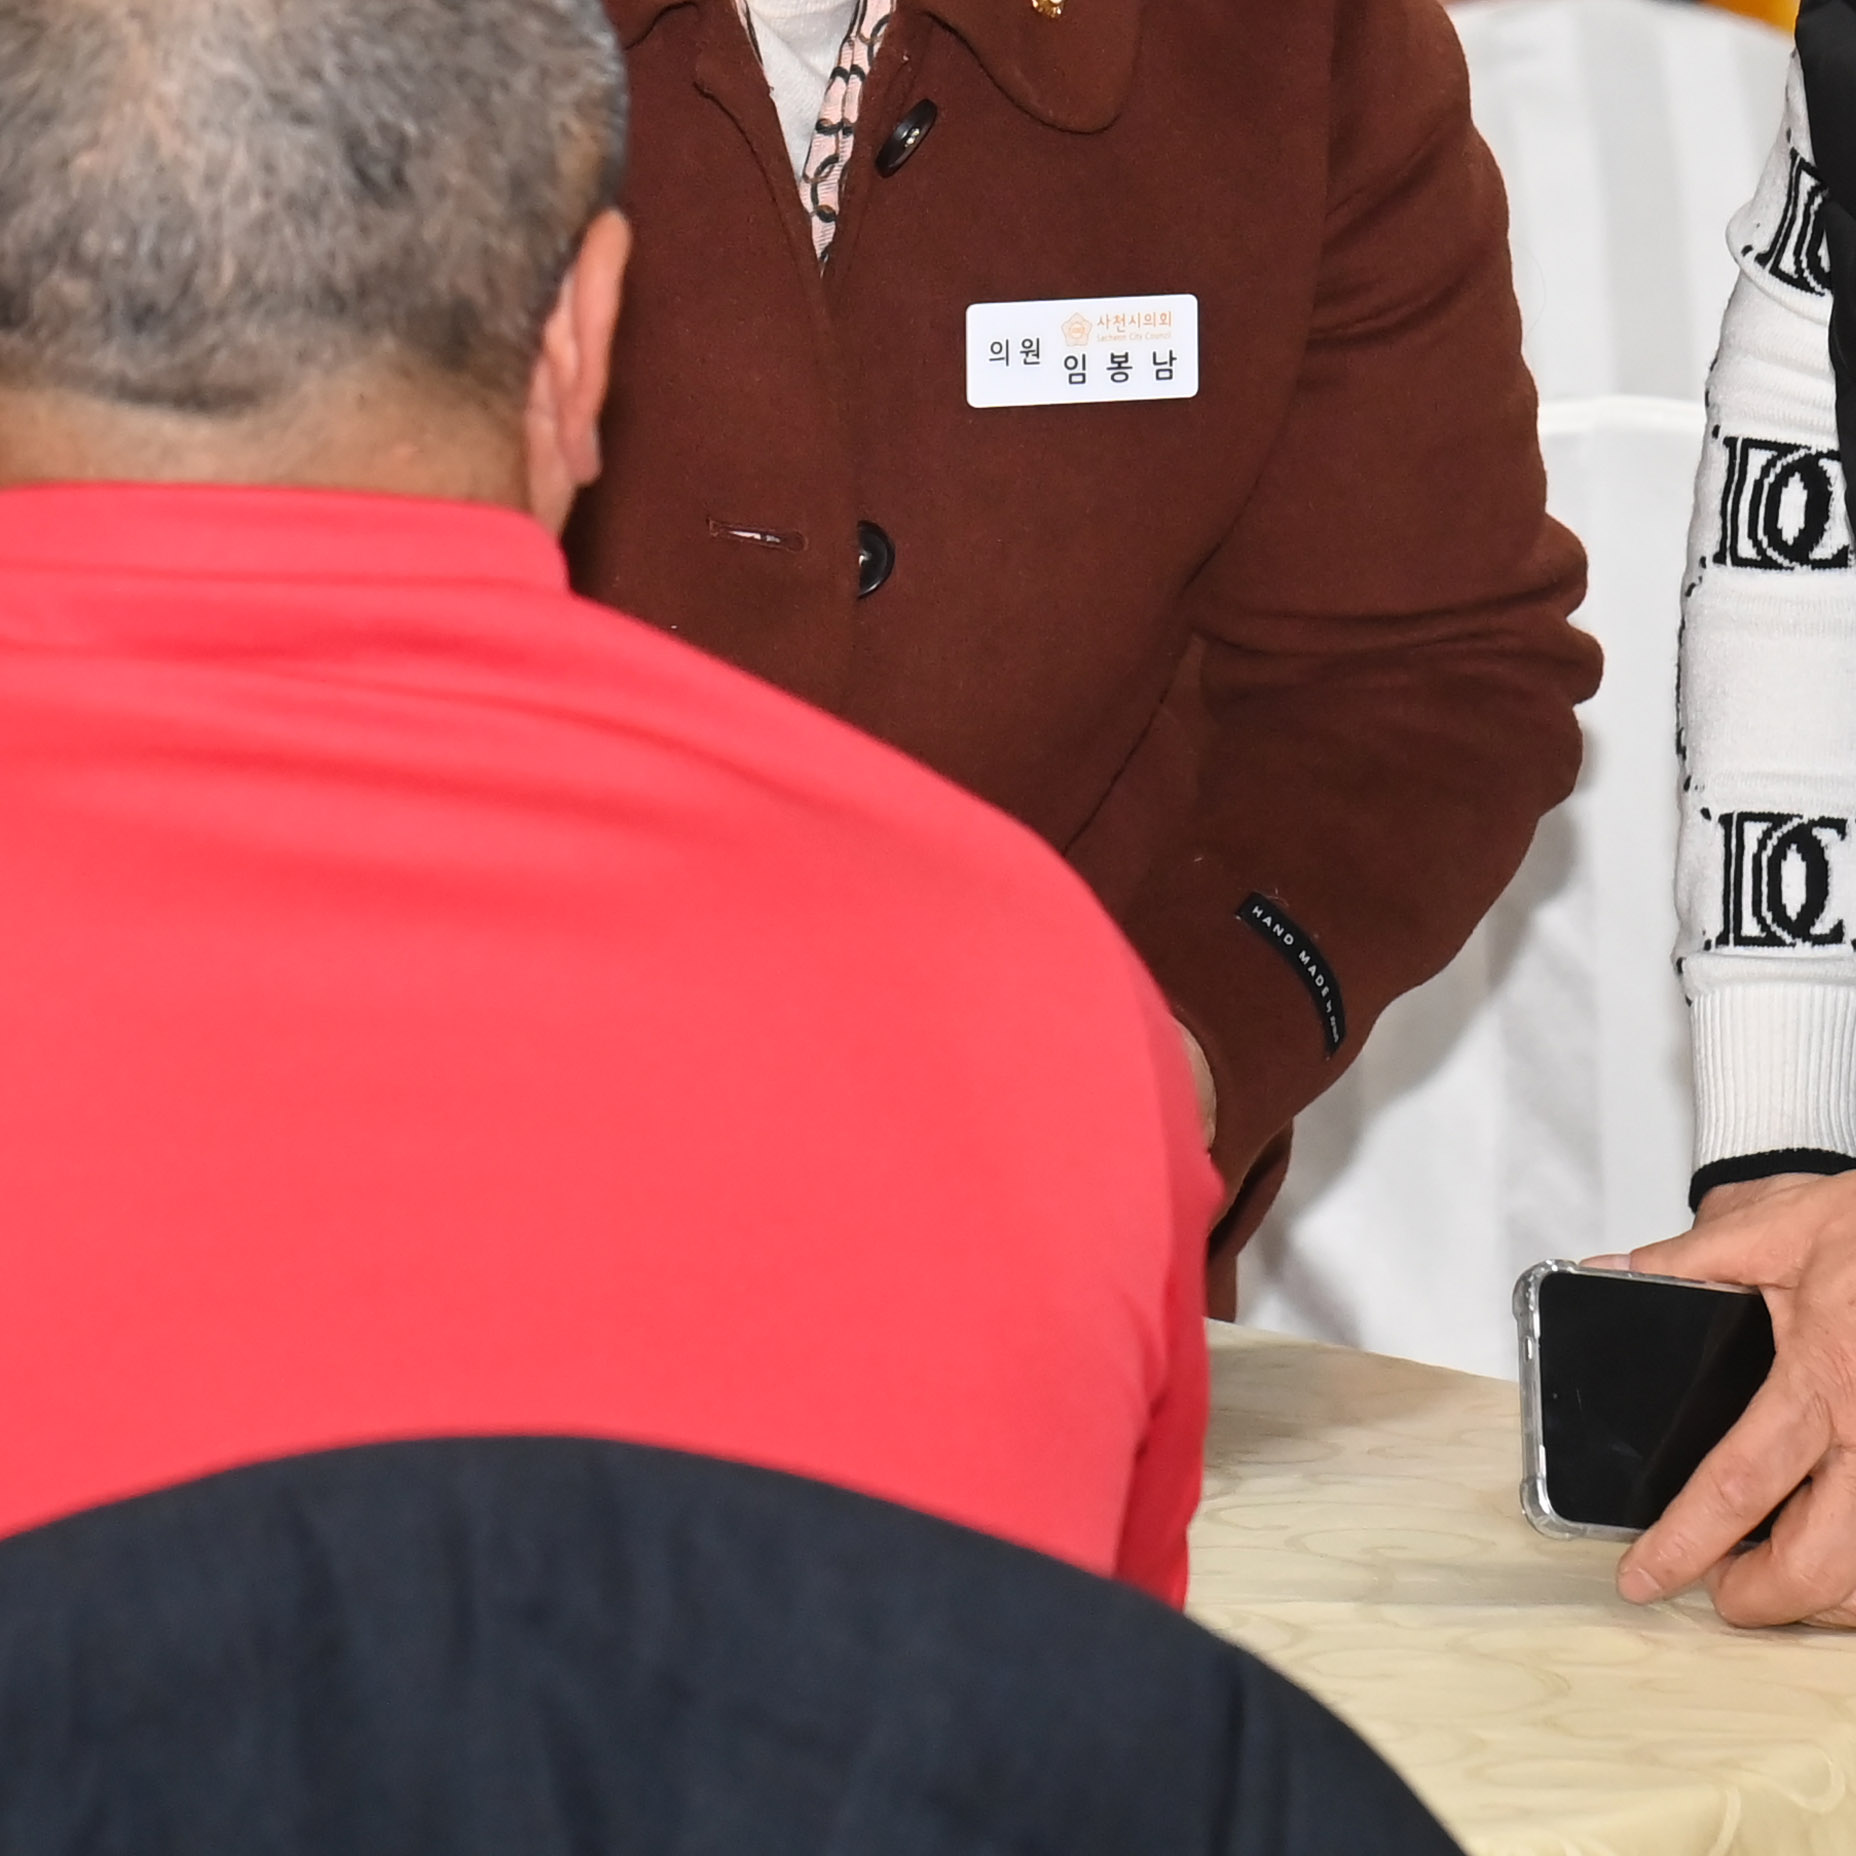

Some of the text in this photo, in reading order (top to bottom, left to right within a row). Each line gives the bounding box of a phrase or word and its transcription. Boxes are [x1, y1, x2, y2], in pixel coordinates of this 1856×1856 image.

[1096, 311, 1172, 333] 사천시의회
[1251, 905, 1331, 997] HAND MADE
